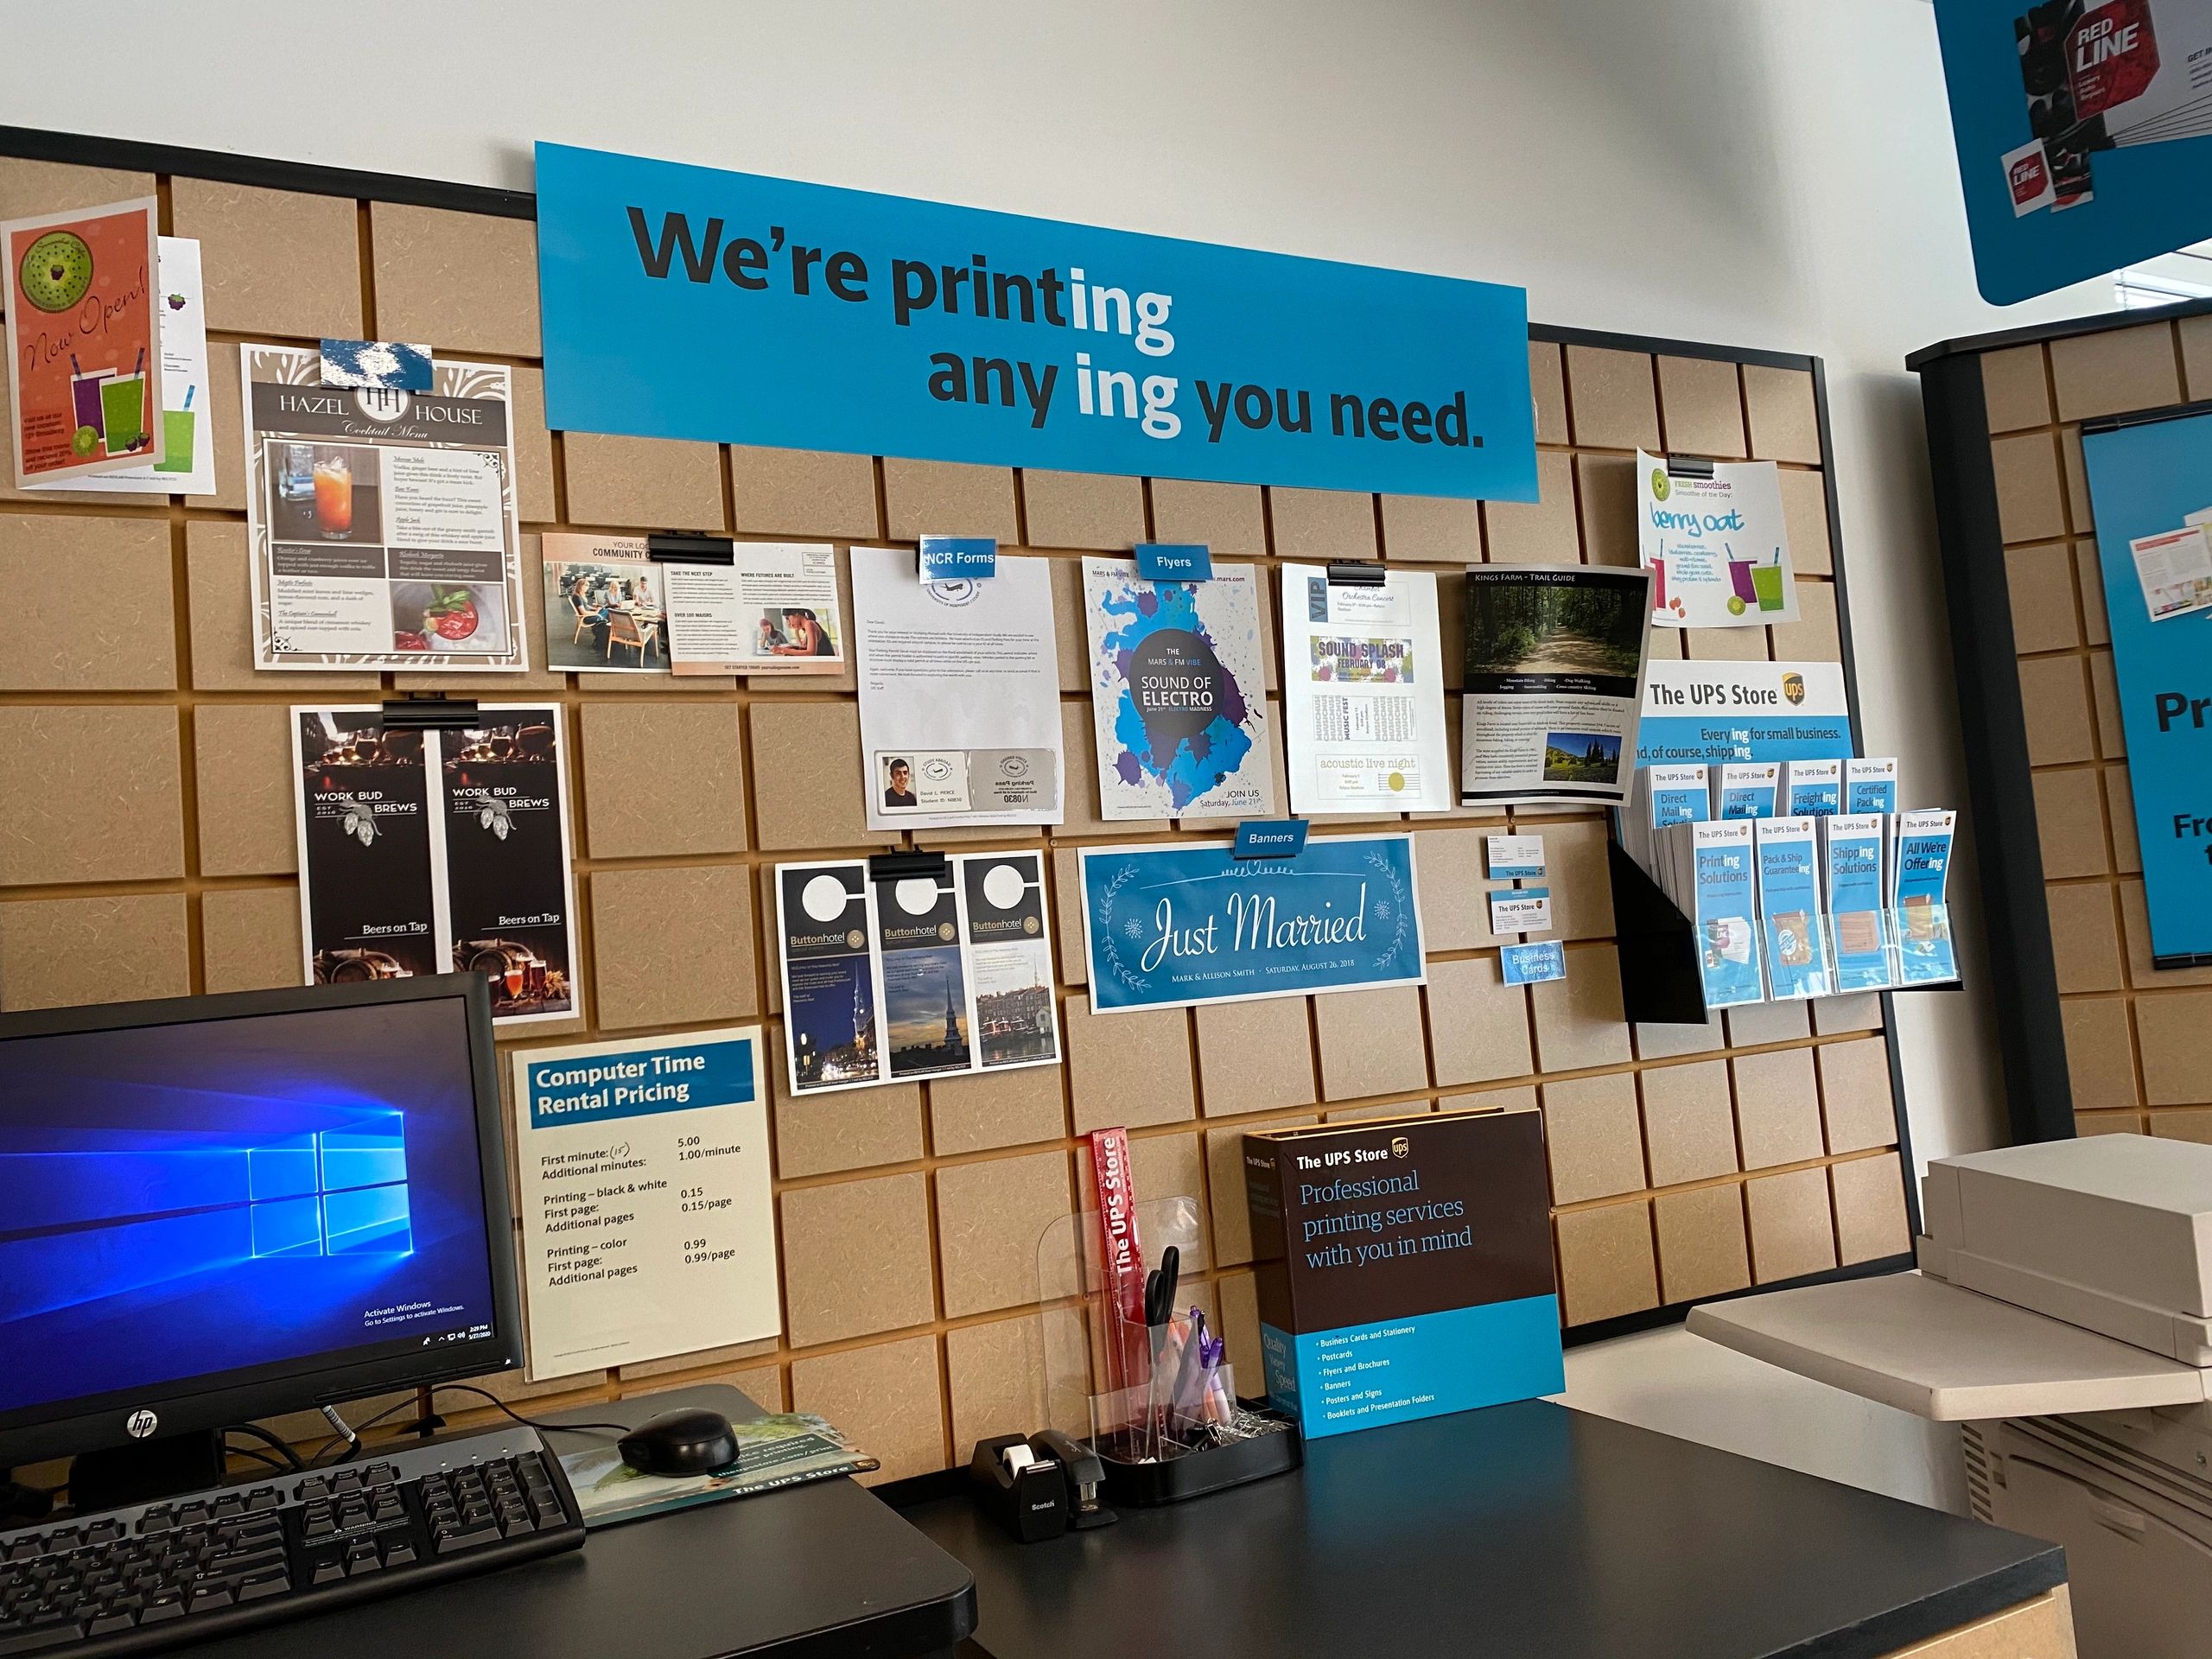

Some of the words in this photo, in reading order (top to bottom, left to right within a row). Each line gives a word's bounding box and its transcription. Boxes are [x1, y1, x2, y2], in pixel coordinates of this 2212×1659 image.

[2077, 17, 2113, 47] RED
[2075, 22, 2139, 73] LINE
[2013, 165, 2040, 186] LINE
[626, 206, 868, 304] We're
[893, 254, 1174, 357] printing
[24, 332, 74, 372] Now
[79, 265, 145, 334] Open!
[929, 352, 1058, 429] any
[1077, 353, 1181, 441] ing
[1195, 379, 1312, 443] you
[1332, 390, 1484, 448] need.
[280, 396, 349, 416] HAZEL
[416, 405, 483, 425] HOUSE
[341, 420, 390, 435] Cocktail
[391, 424, 429, 438] Menu
[1694, 480, 1732, 490] smoothies
[1650, 502, 1702, 537] berry
[1703, 509, 1745, 531] oat
[613, 541, 634, 550] YOUR
[593, 548, 643, 559] COMMUNITY
[928, 552, 953, 565] NCR
[957, 551, 995, 564] Forms
[1157, 556, 1192, 569] Flyers
[1311, 581, 1326, 619] VIP
[1318, 642, 1356, 657] SOUND
[1361, 643, 1403, 658] SPLASH
[1338, 658, 1373, 669] FEBRUARY
[1141, 677, 1189, 689] SOUND
[1193, 677, 1211, 689] OF
[1142, 691, 1213, 706] ELECTRO
[1650, 684, 1684, 705] The
[1690, 685, 1726, 705] UPS
[1732, 685, 1777, 705] Store
[1750, 728, 1765, 741] for
[1767, 728, 1795, 740] small
[1796, 728, 1840, 740] business.
[1652, 745, 1664, 758] of
[1665, 747, 1705, 760] course,
[1707, 745, 1753, 761] shipping.
[1320, 759, 1363, 768] acoustic
[1366, 759, 1384, 768] live
[1387, 759, 1415, 770] night
[315, 791, 353, 801] WORK
[358, 791, 383, 800] BUD
[1226, 789, 1247, 798] JOIN
[1249, 789, 1260, 798] US
[1857, 785, 1887, 795] Certified
[1661, 793, 1688, 804] Direct
[1857, 798, 1885, 808] Packing
[374, 803, 417, 813] BREWS
[1662, 804, 1693, 818] Mailing
[1249, 833, 1294, 843] Banners
[1833, 846, 1874, 861] Shipping
[1906, 842, 1919, 854] All
[1700, 855, 1740, 869] Printing
[1764, 855, 1779, 864] Pack
[1787, 854, 1802, 864] Ship
[1904, 857, 1943, 871] Offering
[1764, 863, 1810, 875] Guaranteeing
[1834, 862, 1877, 874] Solutions
[1700, 871, 1748, 885] Solutions
[363, 924, 391, 935] Beers
[408, 921, 428, 933] Tap
[1141, 897, 1218, 973] Just
[1227, 882, 1367, 951] Married
[790, 931, 844, 945] Buttonhotel
[1513, 953, 1554, 965] Business
[1172, 974, 1193, 982] MARK
[1202, 970, 1231, 981] ALLISON
[1232, 968, 1255, 977] SMITH
[1265, 965, 1300, 975] SATURDAY,
[1301, 963, 1327, 971] AUGUST
[1522, 964, 1548, 975] Cards
[536, 1065, 647, 1089] Computer
[651, 1053, 705, 1077] Time
[537, 1087, 609, 1115] Rental
[614, 1081, 690, 1107] Pricing
[677, 1136, 700, 1147] 5.00
[541, 1153, 566, 1166] First
[567, 1148, 609, 1163] minute:
[678, 1144, 741, 1161] 1.00/minute
[1297, 1155, 1321, 1170] The
[1325, 1151, 1351, 1166] UPS
[1354, 1149, 1388, 1162] Store
[542, 1162, 598, 1179] Additional
[601, 1158, 646, 1173] minutes:
[543, 1190, 586, 1205] Printing
[597, 1183, 625, 1198] black
[627, 1184, 635, 1192] &
[638, 1179, 667, 1192] white
[1300, 1170, 1420, 1205] Professional
[1303, 1210, 1382, 1243] printing
[1387, 1199, 1464, 1226] services
[1306, 1244, 1352, 1268] with
[1357, 1241, 1394, 1267] you
[1397, 1236, 1417, 1255] in
[1421, 1226, 1472, 1251] mind
[365, 1307, 395, 1318] Activate
[397, 1301, 431, 1312] Windows
[383, 1314, 406, 1323] Settings
[414, 1309, 436, 1318] activate
[437, 1305, 465, 1313] Windows.
[132, 1411, 153, 1438] hp
[1032, 1500, 1054, 1510] Scotch
